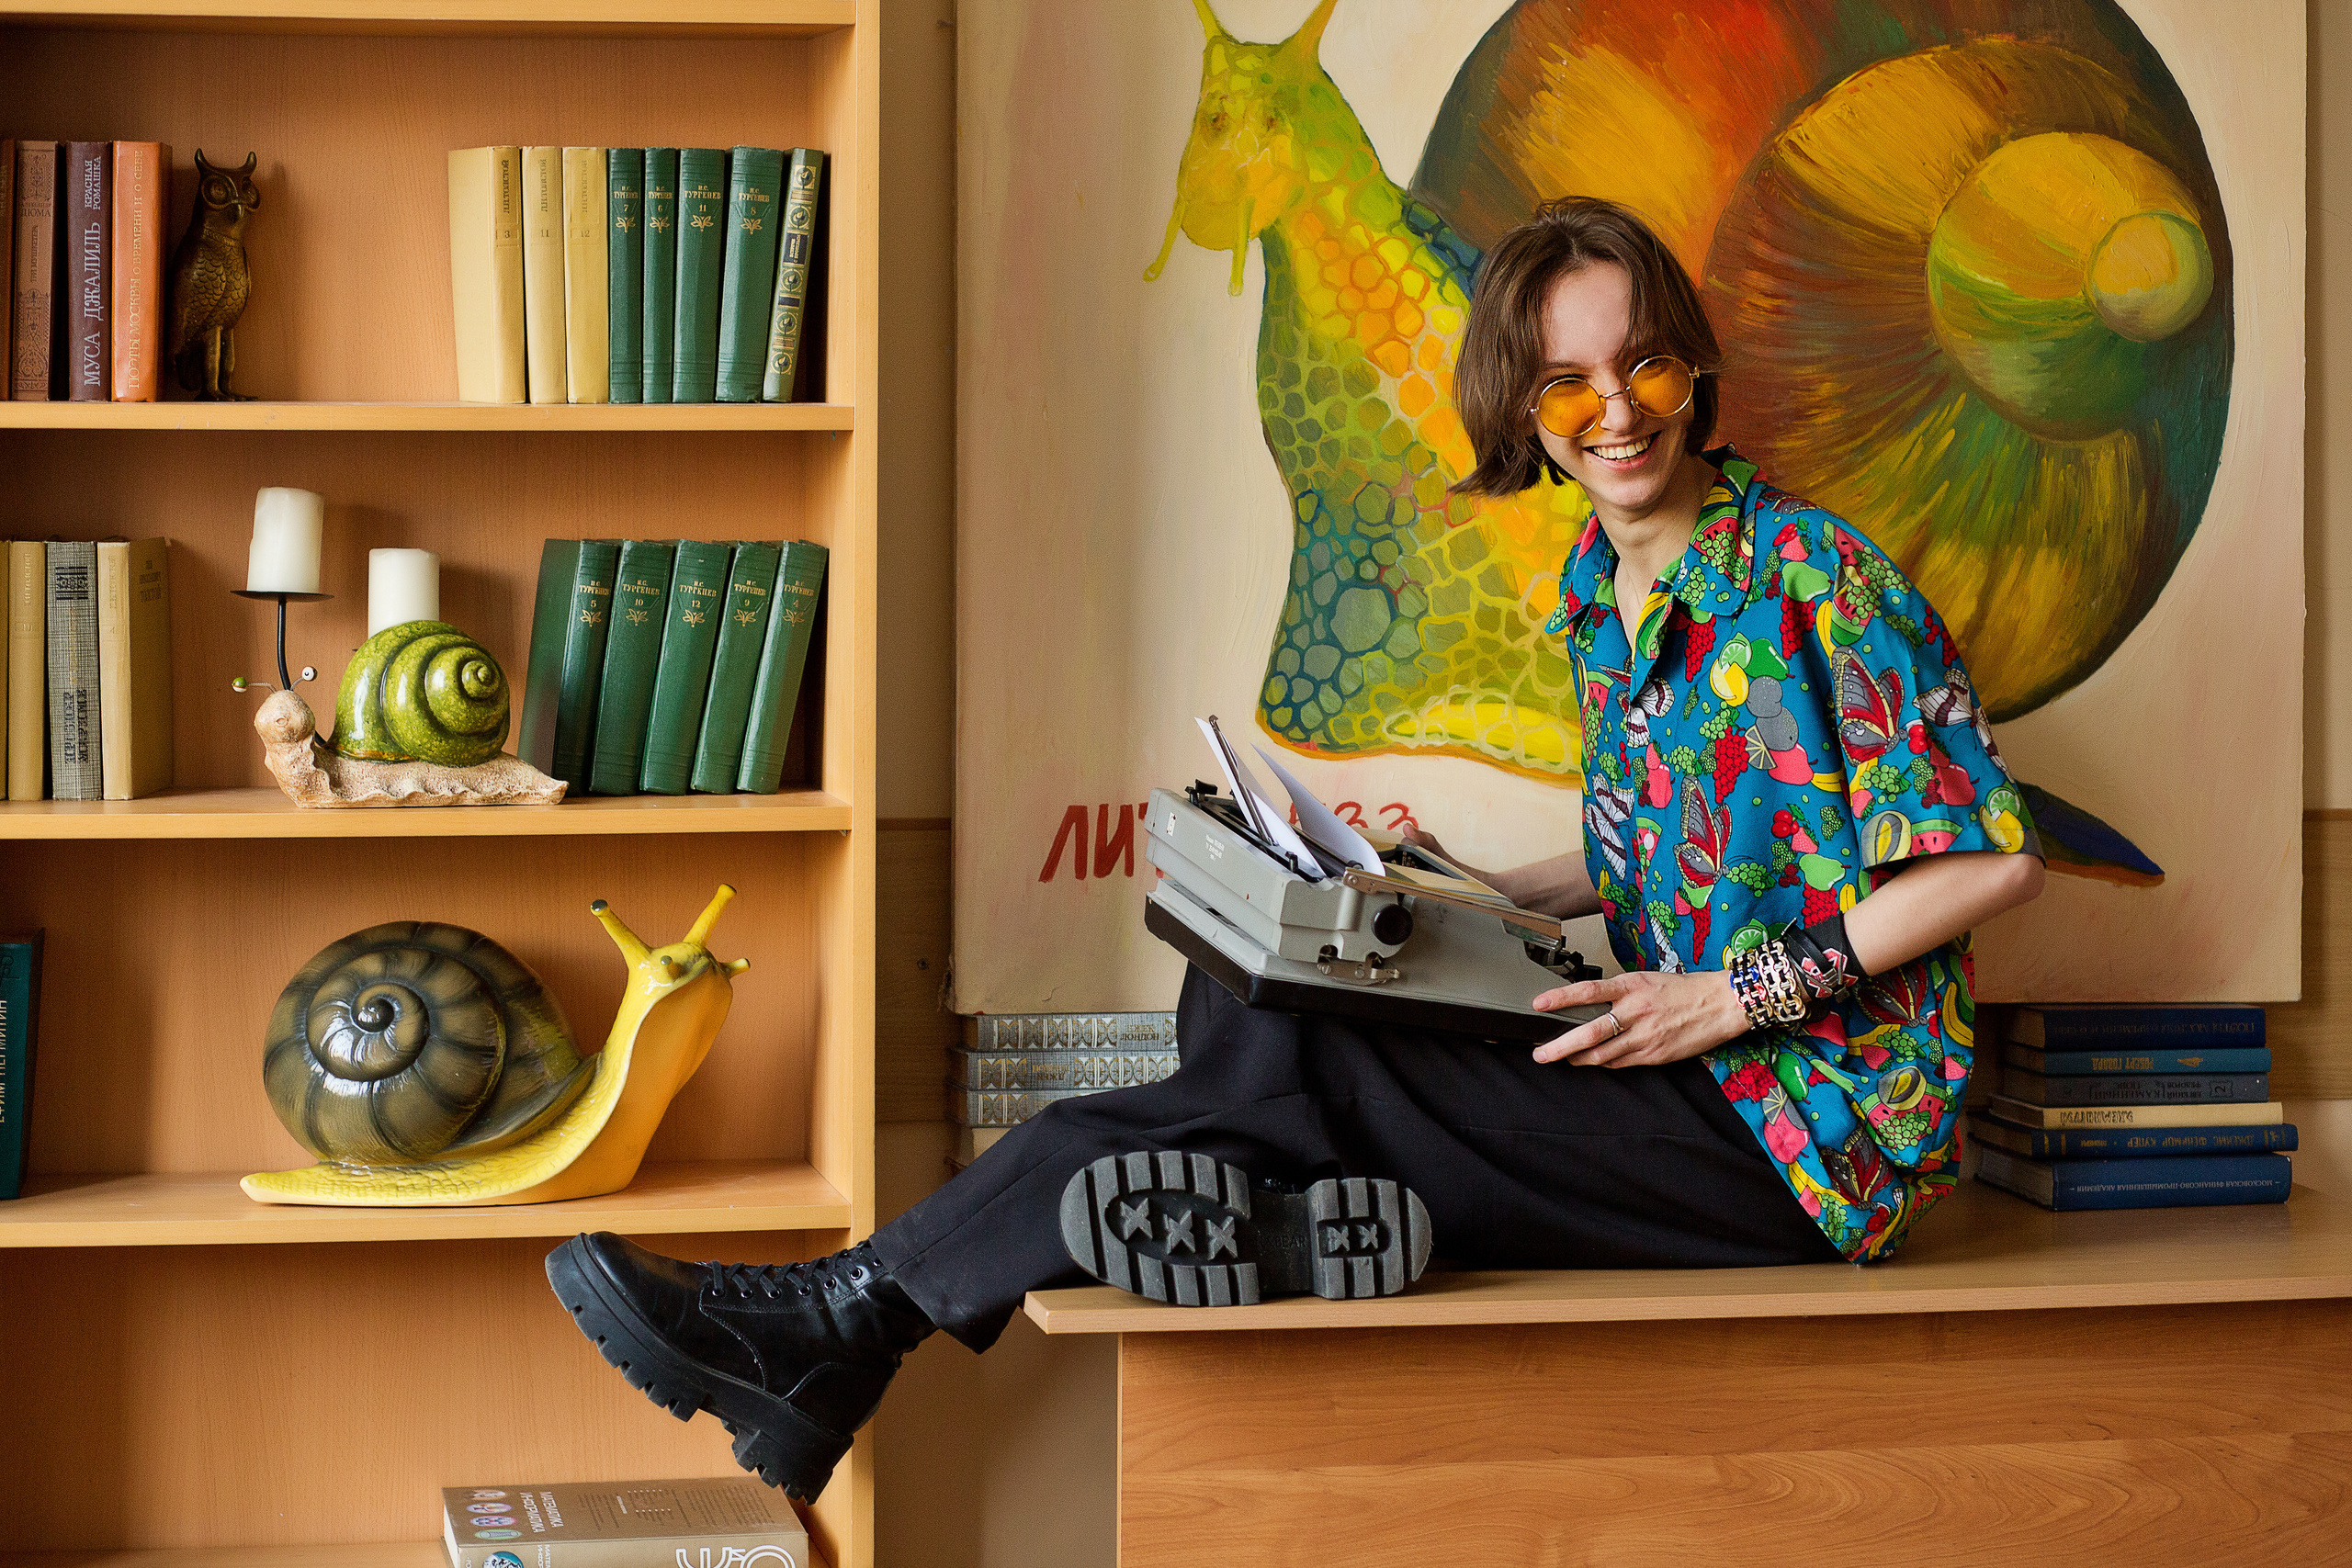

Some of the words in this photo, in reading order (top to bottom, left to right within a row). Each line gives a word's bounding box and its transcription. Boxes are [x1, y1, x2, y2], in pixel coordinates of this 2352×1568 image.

[134, 150, 142, 180] СЕБЕ
[85, 160, 93, 209] КРАСНАЯ
[93, 155, 101, 210] РОМАШКА
[134, 184, 142, 192] О
[614, 191, 639, 199] ТУРГЕНЕВ
[648, 191, 673, 199] ТУРГЕНЕВ
[684, 190, 721, 199] ТУРГЕНЕВ
[738, 192, 770, 202] ТУРГЕНЕВ
[134, 197, 142, 206] И
[623, 204, 628, 212] 7
[657, 204, 663, 212] 6
[699, 204, 707, 212] 11
[750, 207, 756, 216] 8
[21, 209, 51, 218] ДЮМА
[133, 209, 142, 265] ВРЕМЕНИ
[504, 230, 511, 239] 3
[541, 229, 549, 238] 11
[581, 230, 590, 238] 12
[84, 221, 104, 321] ДЖАЛИЛЬ
[133, 266, 141, 275] О
[129, 277, 141, 336] МОСКВЫ
[84, 331, 101, 387] МУСА
[128, 337, 141, 389] ПОЭТЫ
[579, 585, 610, 596] ТУРГЕНЕВ
[622, 583, 661, 595] ТУРГЕНЕВ
[679, 584, 717, 597] ТУРГЕНЕВ
[733, 583, 766, 596] ТУРГЕНЕВ
[784, 583, 815, 596] ТУРГЕНЕВ
[590, 600, 597, 608] 5
[634, 598, 644, 606] 10
[691, 600, 701, 608] 12
[793, 599, 798, 607] 4
[1126, 1023, 1156, 1032] ДЖЕК
[1120, 1032, 1159, 1042] ЛОНДОН
[2125, 1057, 2154, 1070] РОБЕРТ
[2214, 1085, 2226, 1093] 2
[2127, 1137, 2156, 1147] КУПЕР
[2162, 1136, 2207, 1147] ФЕНИМОР
[2076, 1184, 2116, 1192] АКАДЕМИЯ
[2117, 1181, 2224, 1191] ФИНАНСОВО-ПРОМЫШЛЕННАЯ
[519, 1491, 546, 1533] ИНФОРМАТИКА
[539, 1491, 564, 1529] МАТЕМАТИКА
